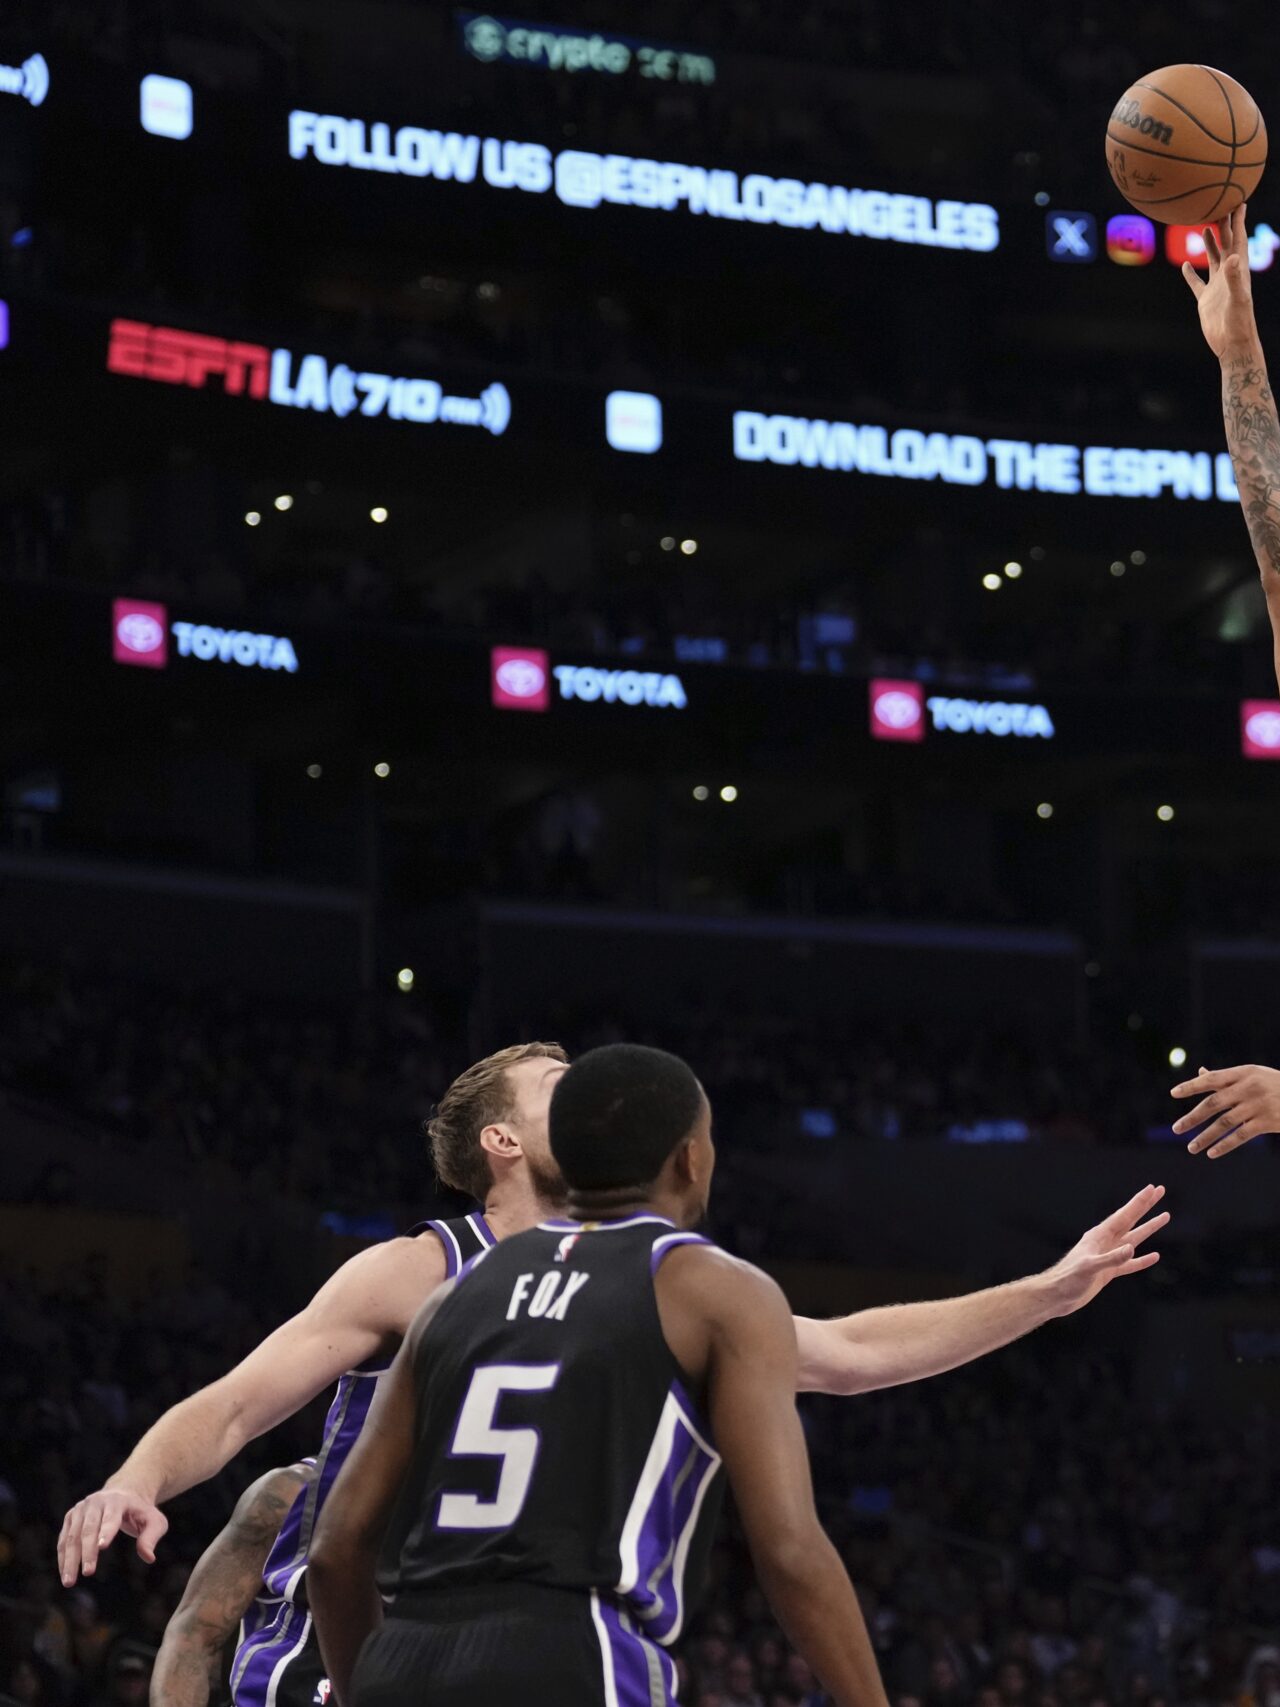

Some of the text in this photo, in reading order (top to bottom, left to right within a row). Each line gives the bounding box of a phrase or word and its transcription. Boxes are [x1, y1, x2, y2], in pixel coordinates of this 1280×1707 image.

[1110, 96, 1174, 147] ilson
[288, 109, 1000, 252] FOLLOW US @ESPNLOSANGELES
[732, 410, 987, 487] DOWNLOAD
[986, 438, 1082, 495] THE
[1083, 446, 1213, 501] ESPN
[171, 621, 299, 673] TOYOTA
[553, 663, 689, 710] TOYOTA
[926, 696, 1055, 739] TOYOTA
[506, 1270, 590, 1321] FOX
[434, 1361, 563, 1532] 5
